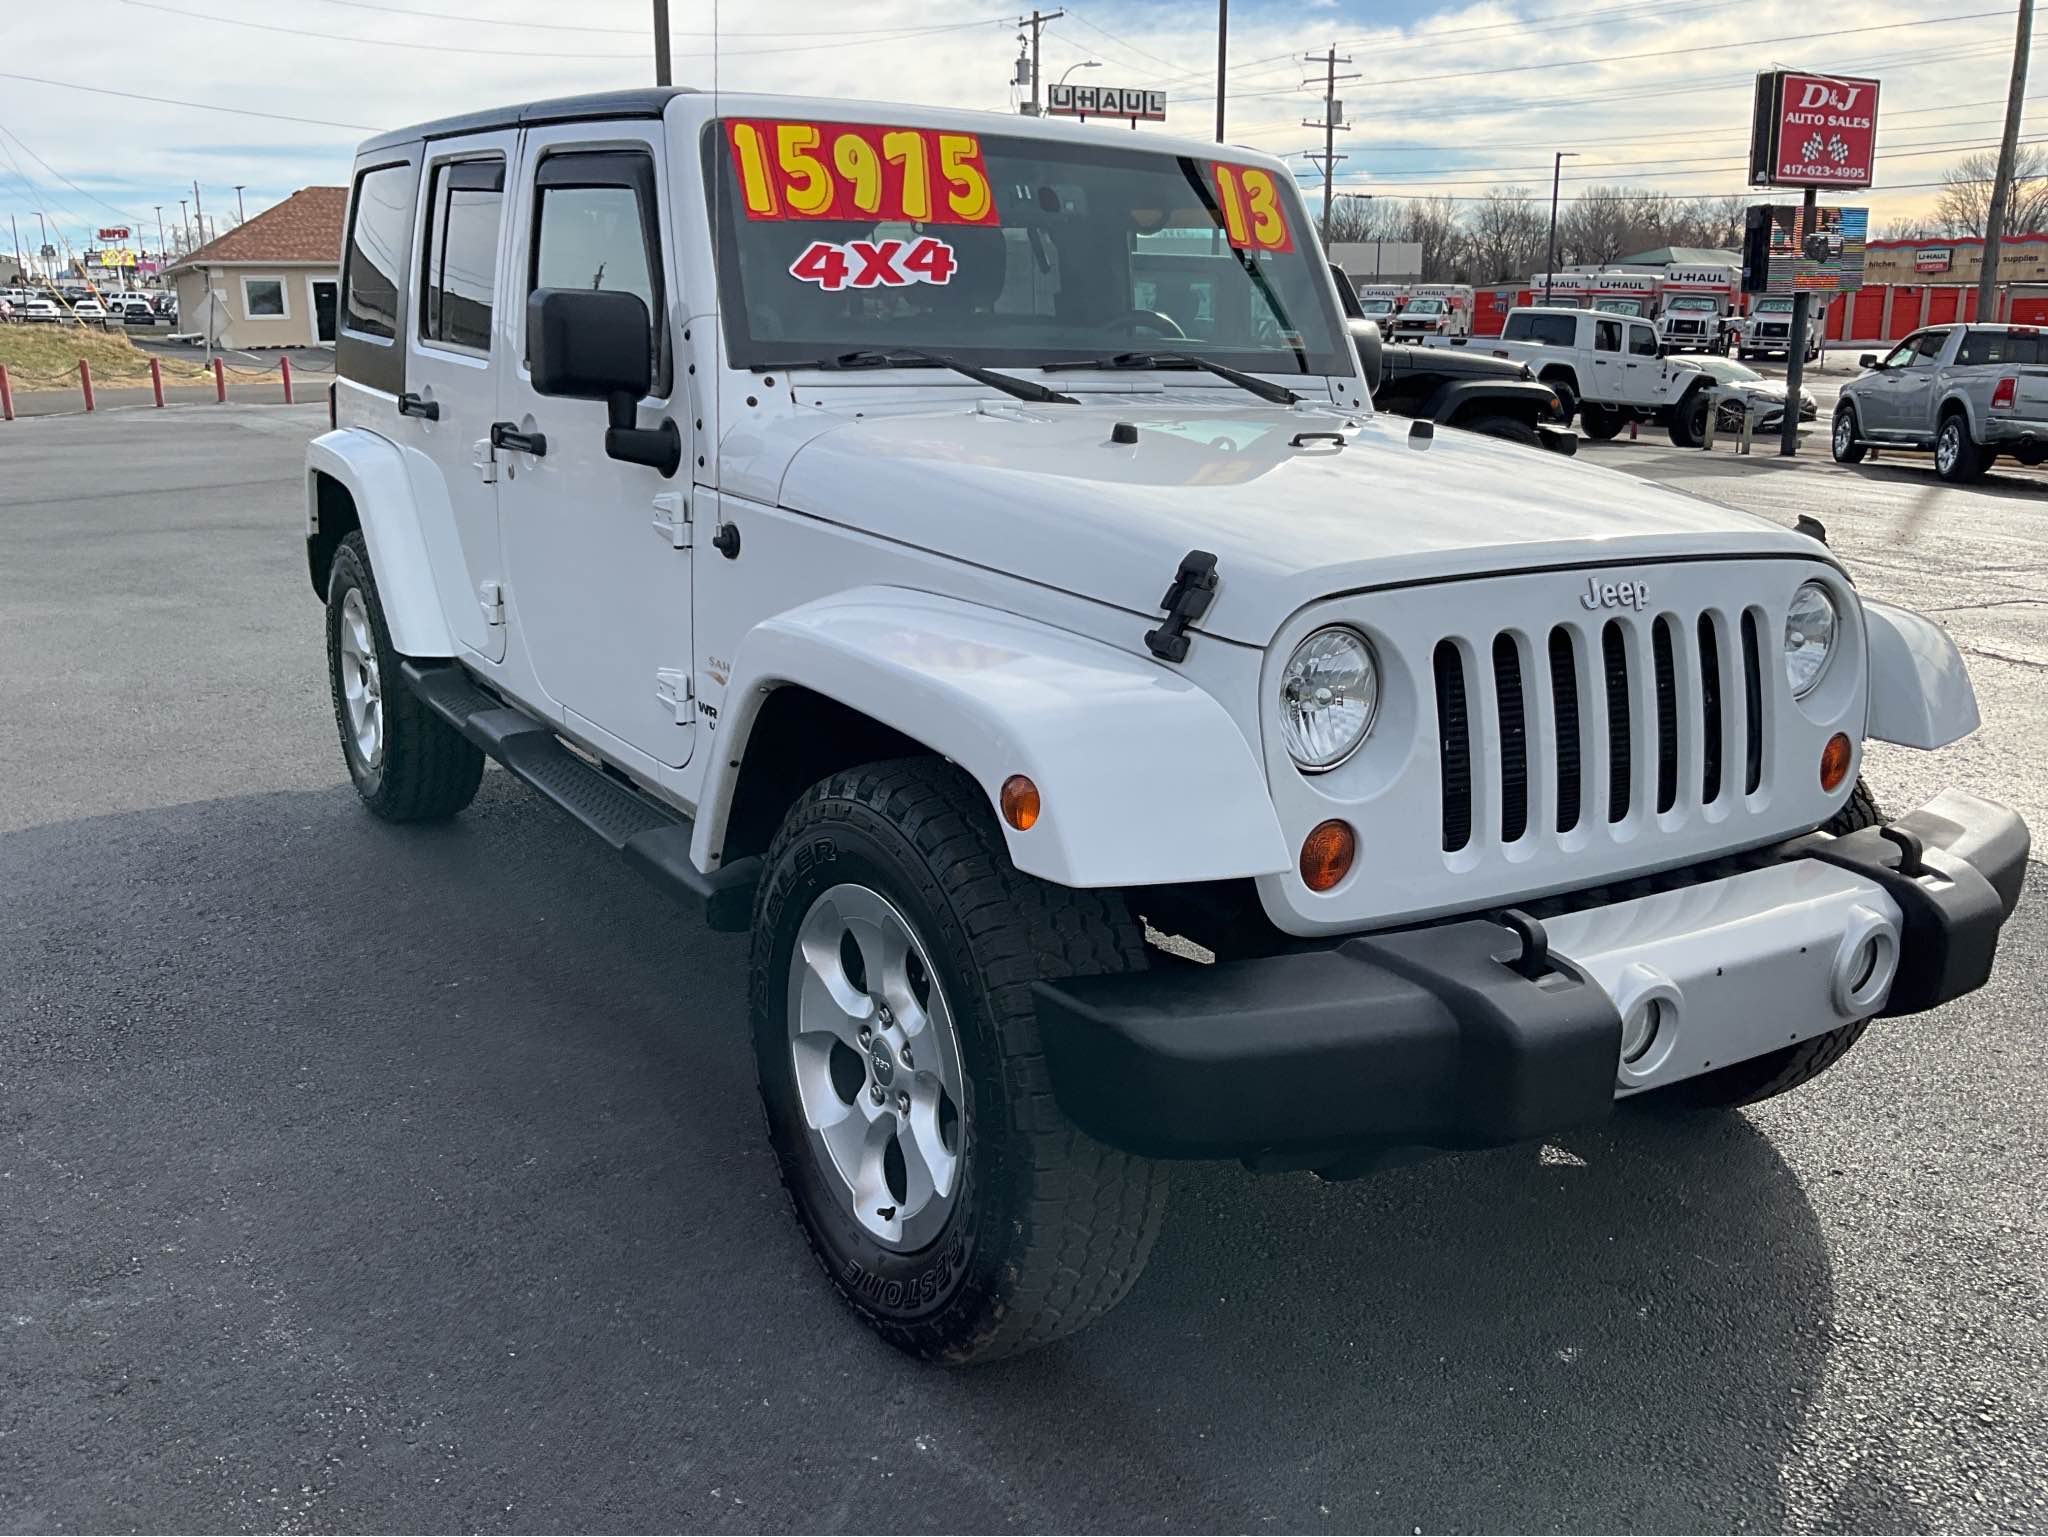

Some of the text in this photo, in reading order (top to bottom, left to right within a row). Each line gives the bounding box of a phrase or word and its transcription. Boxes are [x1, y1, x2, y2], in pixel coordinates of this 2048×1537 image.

[1799, 83, 1861, 111] D&J
[1785, 112, 1870, 128] AUTO SALES
[732, 123, 991, 222] 15975
[1216, 165, 1287, 249] 13
[99, 229, 129, 238] ROPER
[2003, 255, 2039, 264] supplies
[1581, 577, 1650, 612] Jeep
